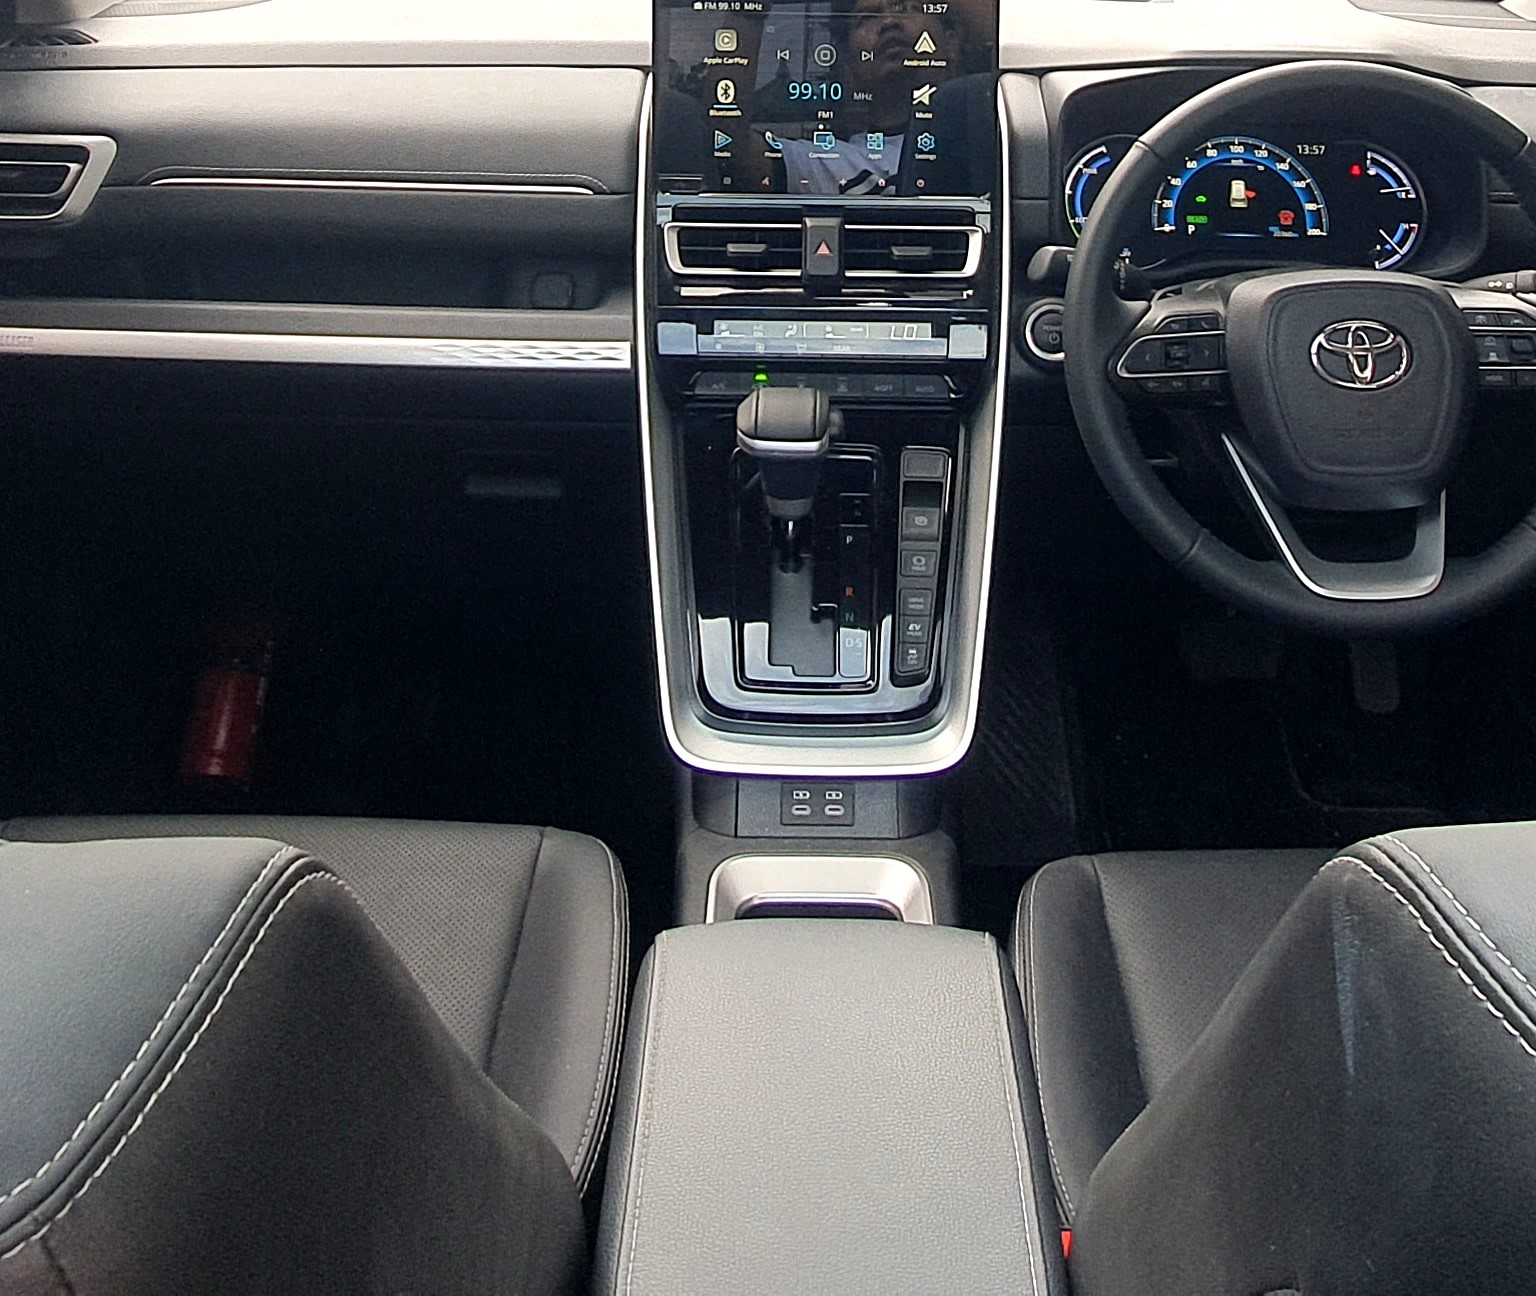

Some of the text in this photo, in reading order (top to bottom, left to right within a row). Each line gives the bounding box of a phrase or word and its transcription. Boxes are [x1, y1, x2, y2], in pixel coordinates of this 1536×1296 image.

[704, 1, 763, 11] FM 99.10 MHz
[922, 3, 948, 14] 13:57
[788, 82, 873, 101] 99.10 MHz
[817, 110, 834, 119] FM1
[1206, 149, 1218, 158] 80
[1229, 145, 1245, 154] 100
[1254, 149, 1269, 158] 120
[1296, 144, 1326, 155] 13:57
[1186, 160, 1198, 169] 60
[1275, 161, 1290, 171] 140
[1170, 177, 1182, 186] 40
[1292, 180, 1307, 189] 160
[1161, 199, 1173, 208] 20
[1187, 224, 1196, 235] P
[846, 535, 853, 544] P
[845, 586, 854, 597] R
[845, 612, 854, 622] N
[845, 637, 863, 648] D S
